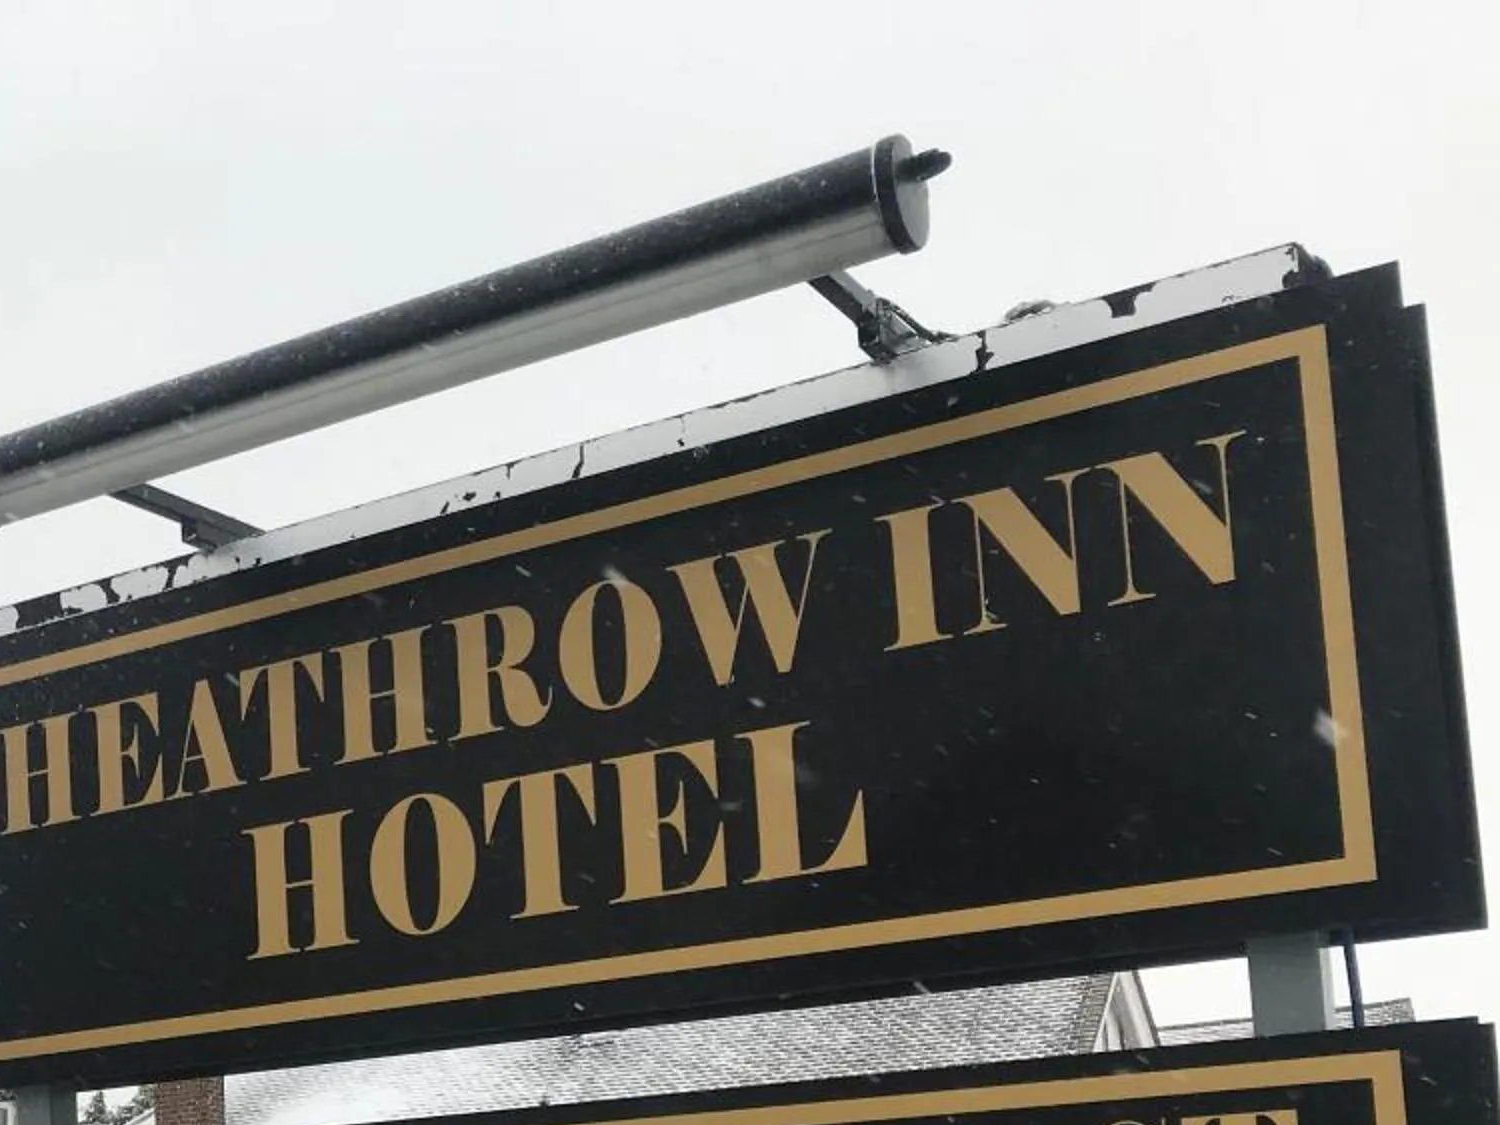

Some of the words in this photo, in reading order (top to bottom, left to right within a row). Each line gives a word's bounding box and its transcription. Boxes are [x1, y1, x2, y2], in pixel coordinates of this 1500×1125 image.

[0, 528, 833, 836] HEATHROW
[875, 430, 1247, 653] INN
[241, 720, 869, 961] HOTEL
